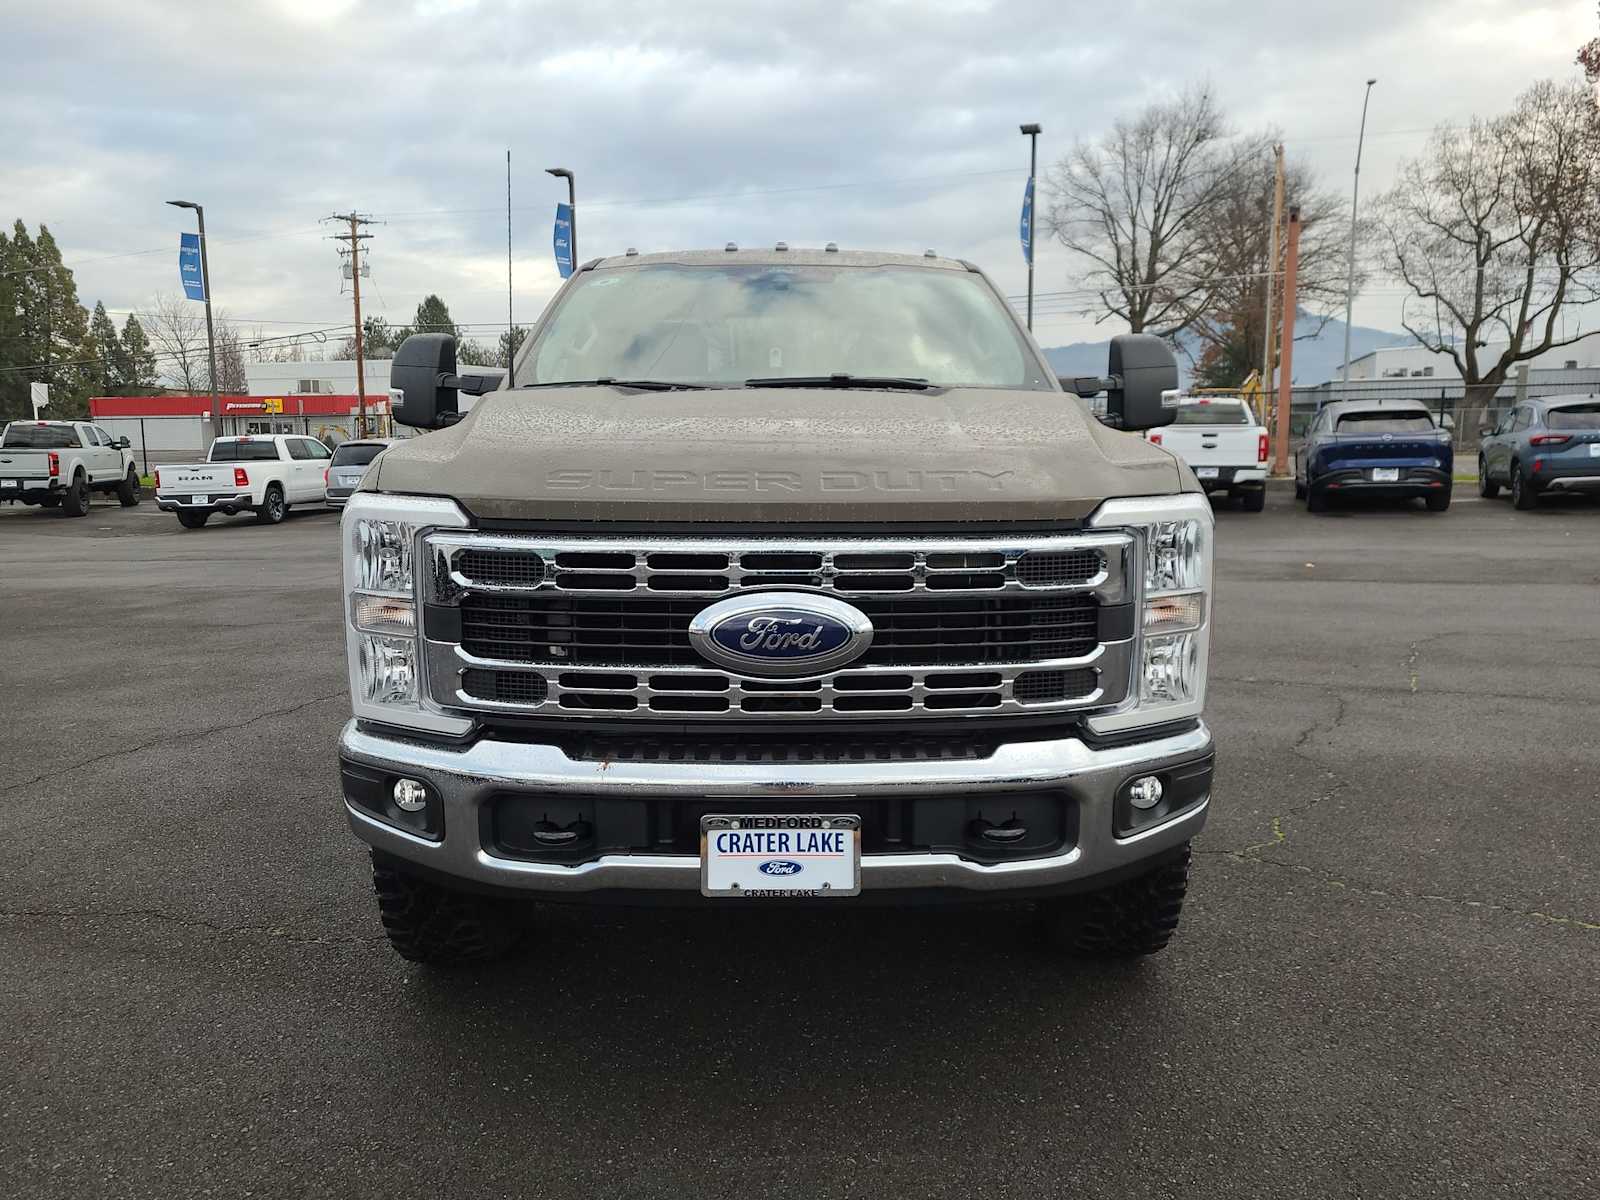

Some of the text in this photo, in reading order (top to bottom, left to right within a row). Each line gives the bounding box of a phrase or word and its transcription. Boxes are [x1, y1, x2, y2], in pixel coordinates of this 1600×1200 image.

[546, 469, 1015, 492] SUPER DUTY
[739, 616, 824, 650] Ford
[739, 817, 823, 829] MEDFORD
[716, 833, 844, 853] CRATER LAKE
[766, 862, 795, 875] Ford
[744, 889, 819, 897] CRATER LAKE
